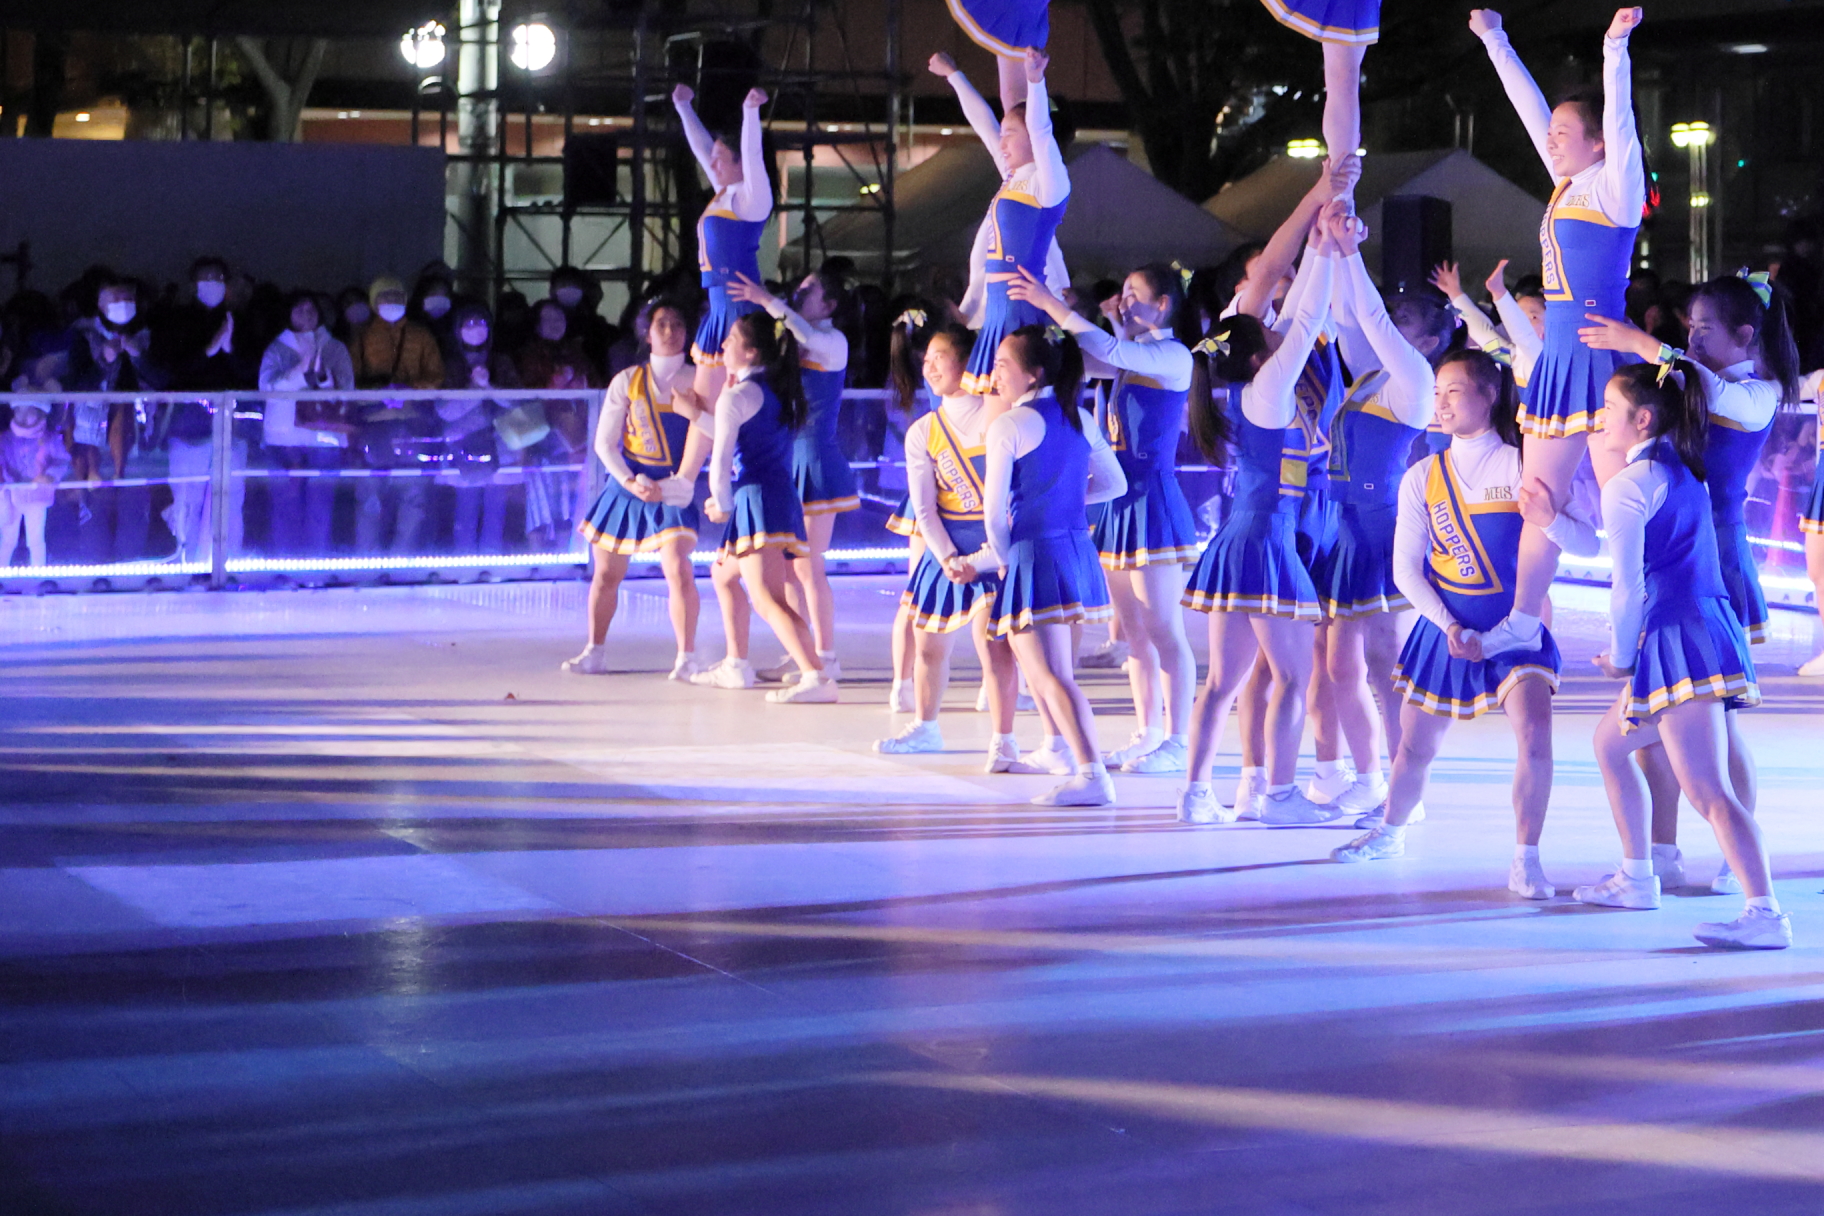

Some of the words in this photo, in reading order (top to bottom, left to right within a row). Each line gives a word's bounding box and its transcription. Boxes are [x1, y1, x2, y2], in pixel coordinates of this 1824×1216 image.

[938, 448, 976, 510] HOPPERS
[1484, 486, 1512, 501] MHS
[1433, 500, 1476, 578] HOPPERS
